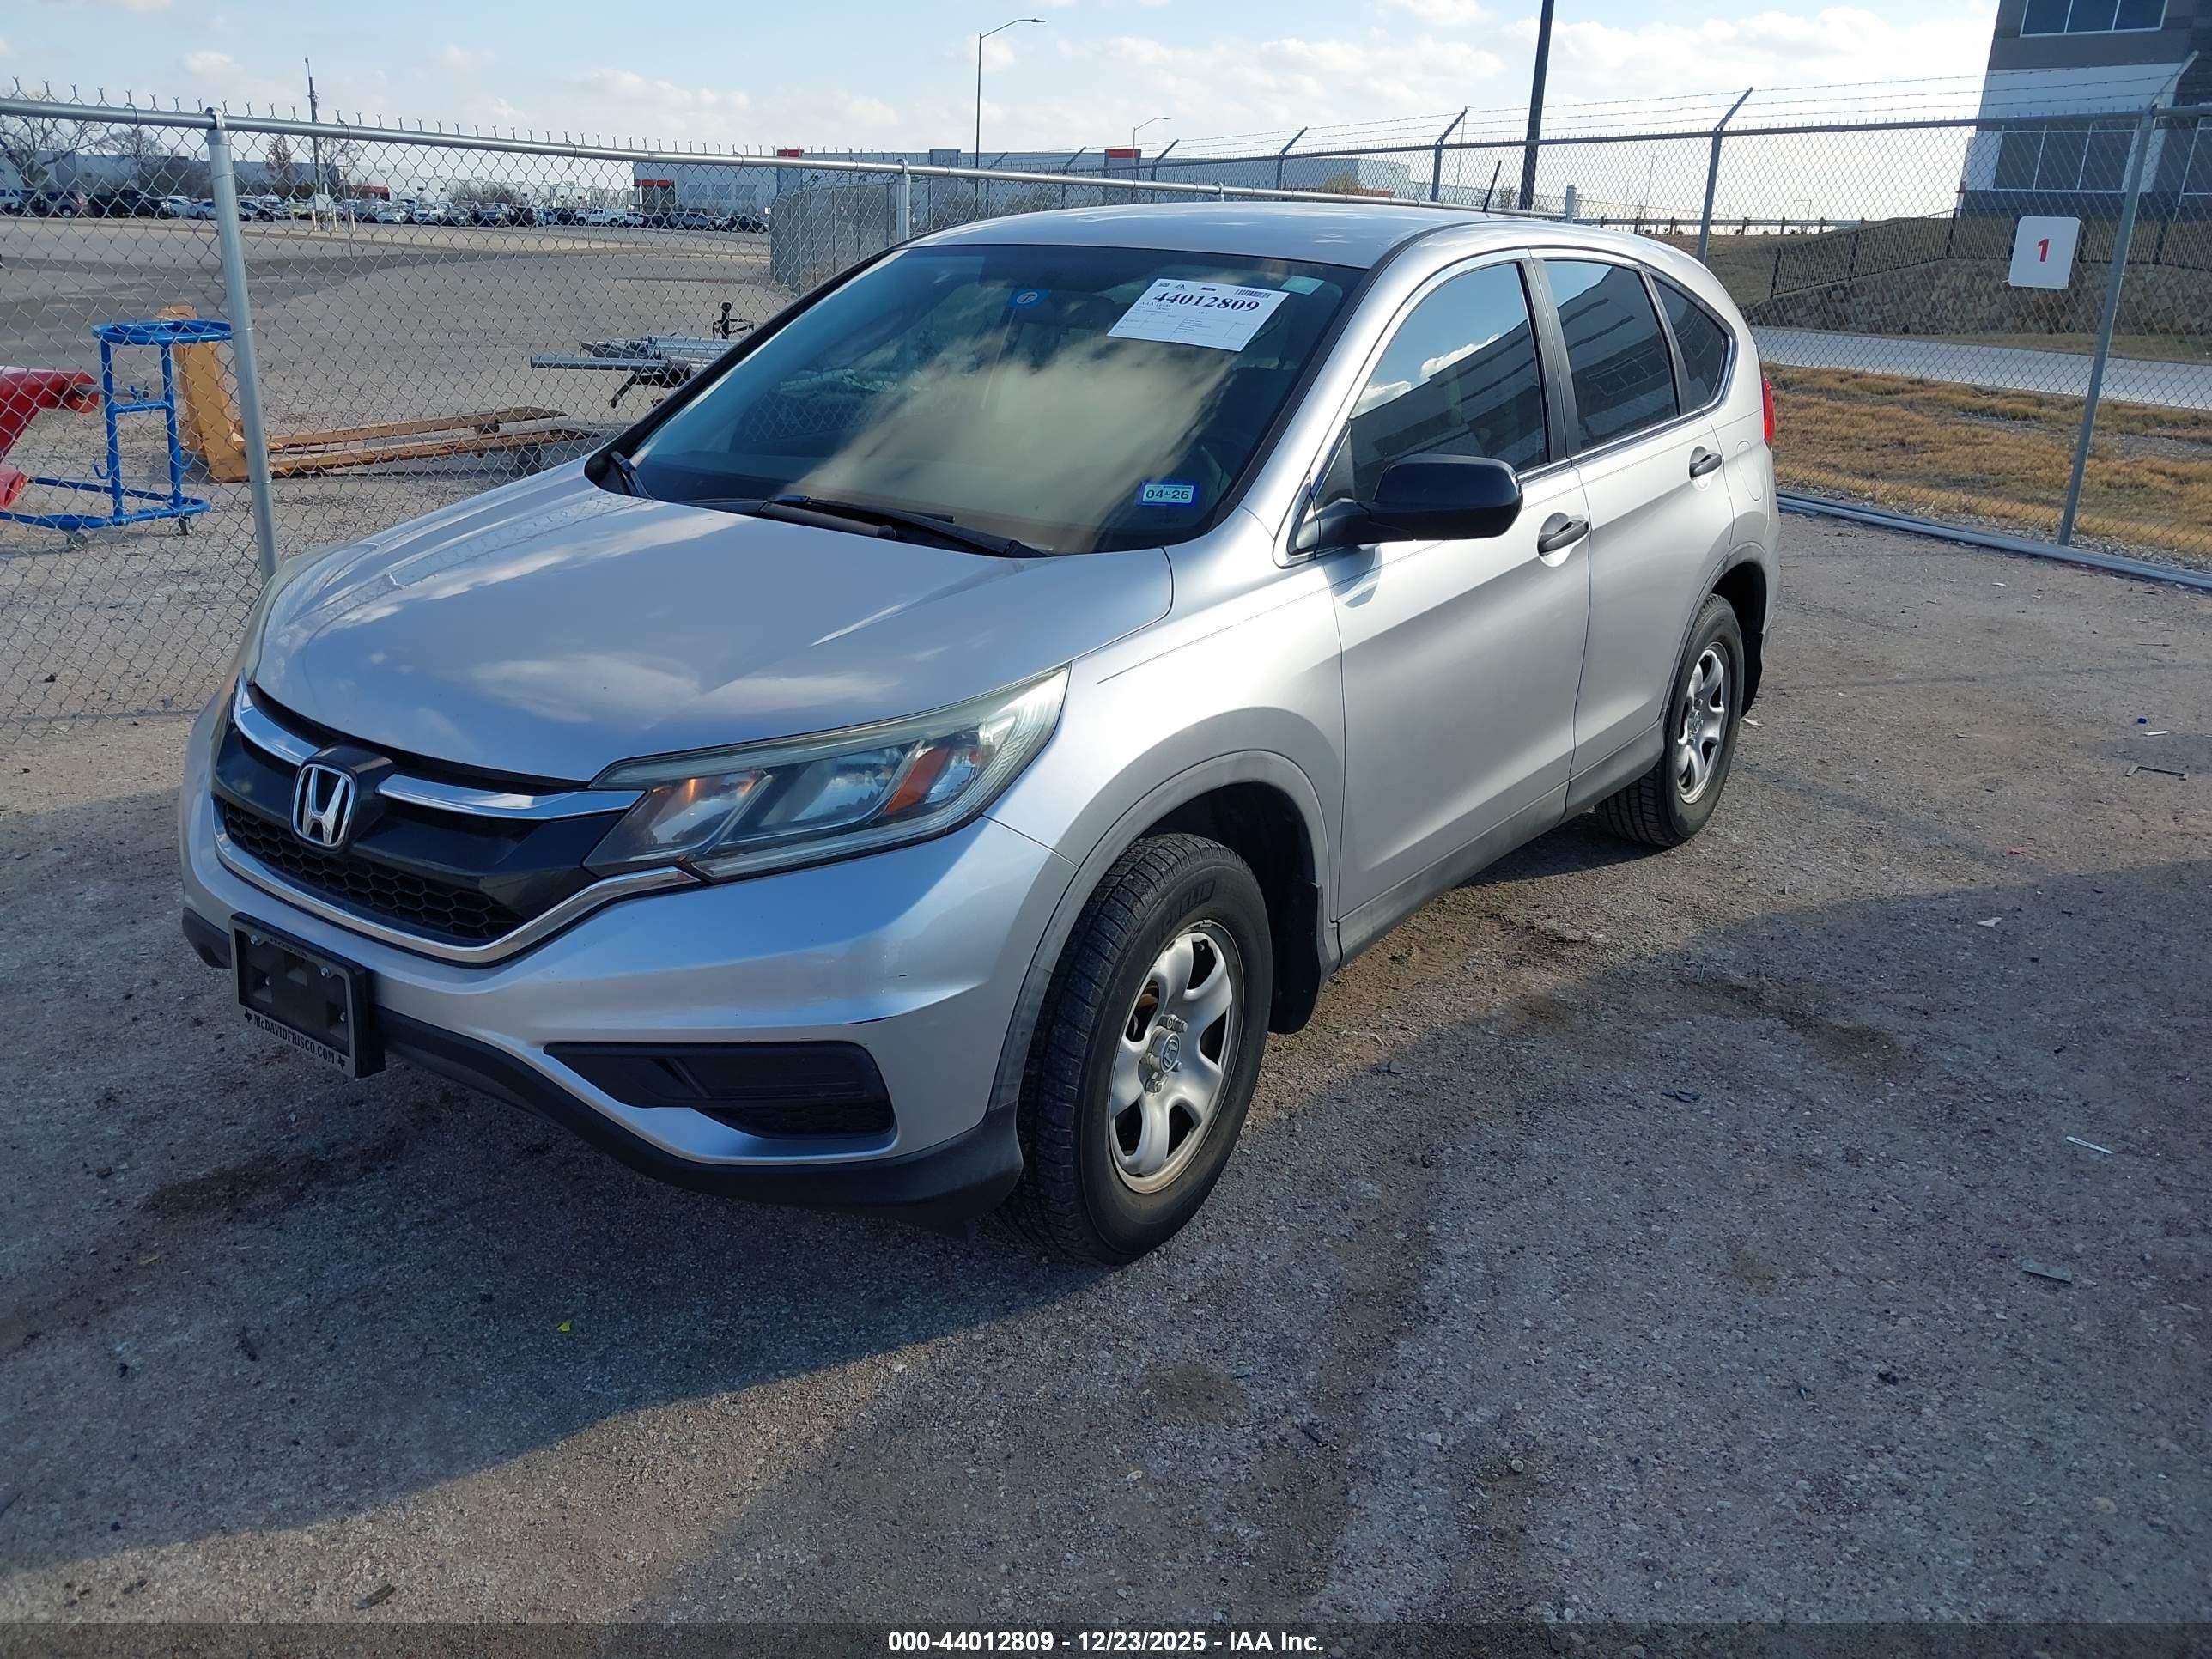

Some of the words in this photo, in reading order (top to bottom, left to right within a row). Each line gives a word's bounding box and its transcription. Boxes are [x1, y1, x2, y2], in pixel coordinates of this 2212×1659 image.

[2037, 238, 2050, 263] 1
[1153, 291, 1260, 312] 44012809
[1146, 489, 1164, 499] 04
[1171, 489, 1189, 500] 26
